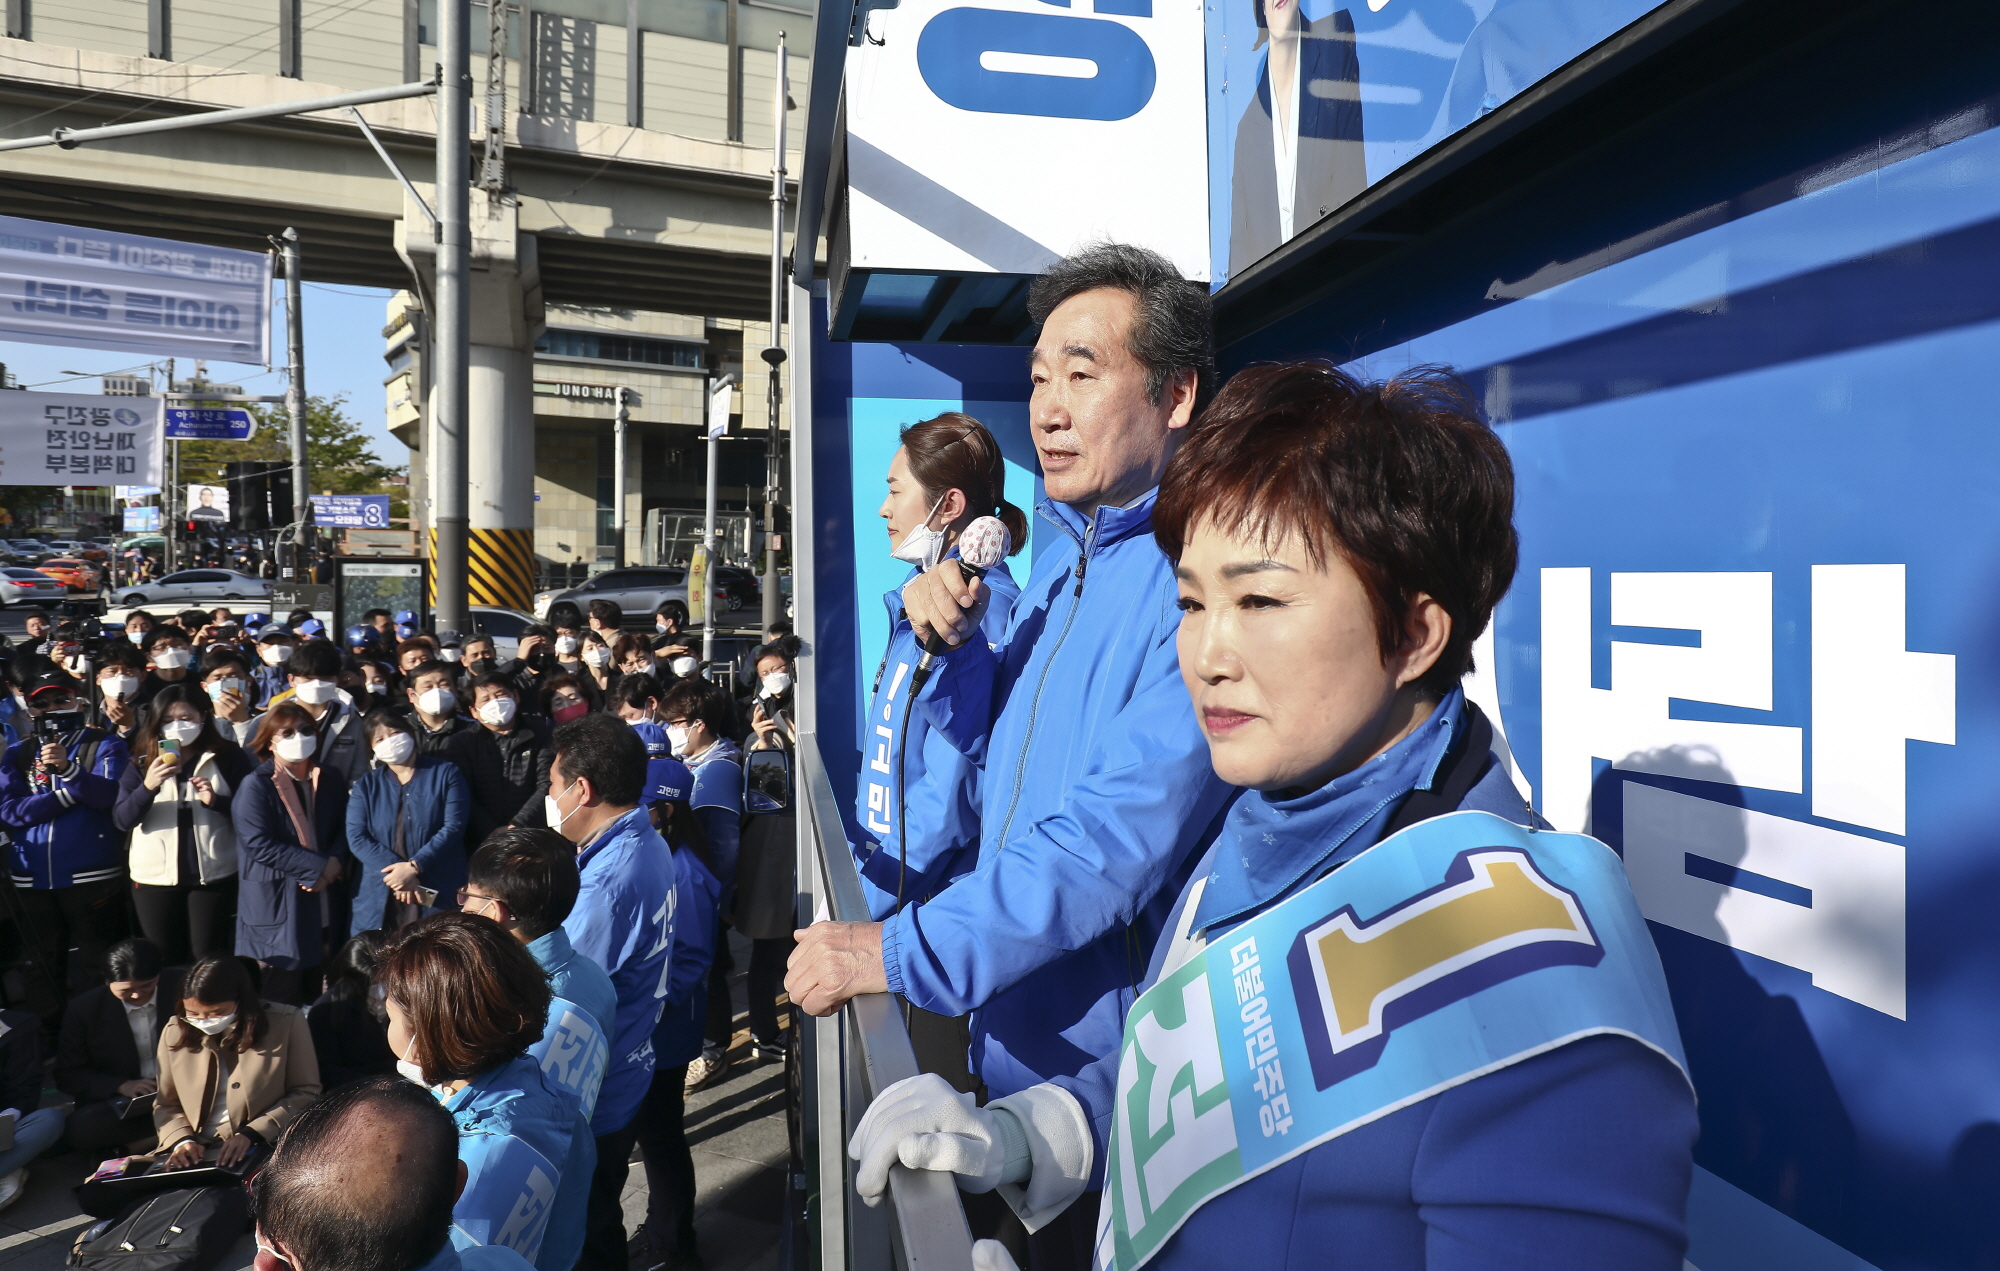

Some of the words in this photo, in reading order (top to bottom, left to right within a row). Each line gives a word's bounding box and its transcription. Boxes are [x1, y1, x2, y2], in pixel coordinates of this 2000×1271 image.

[553, 383, 590, 397] JUNO
[595, 386, 616, 400] HA
[229, 420, 247, 429] 250
[364, 503, 383, 527] 8
[647, 742, 665, 751] 고민정
[656, 784, 681, 798] 고민정
[1290, 847, 1603, 1085] 1
[1229, 935, 1294, 1138] 더불어민주당
